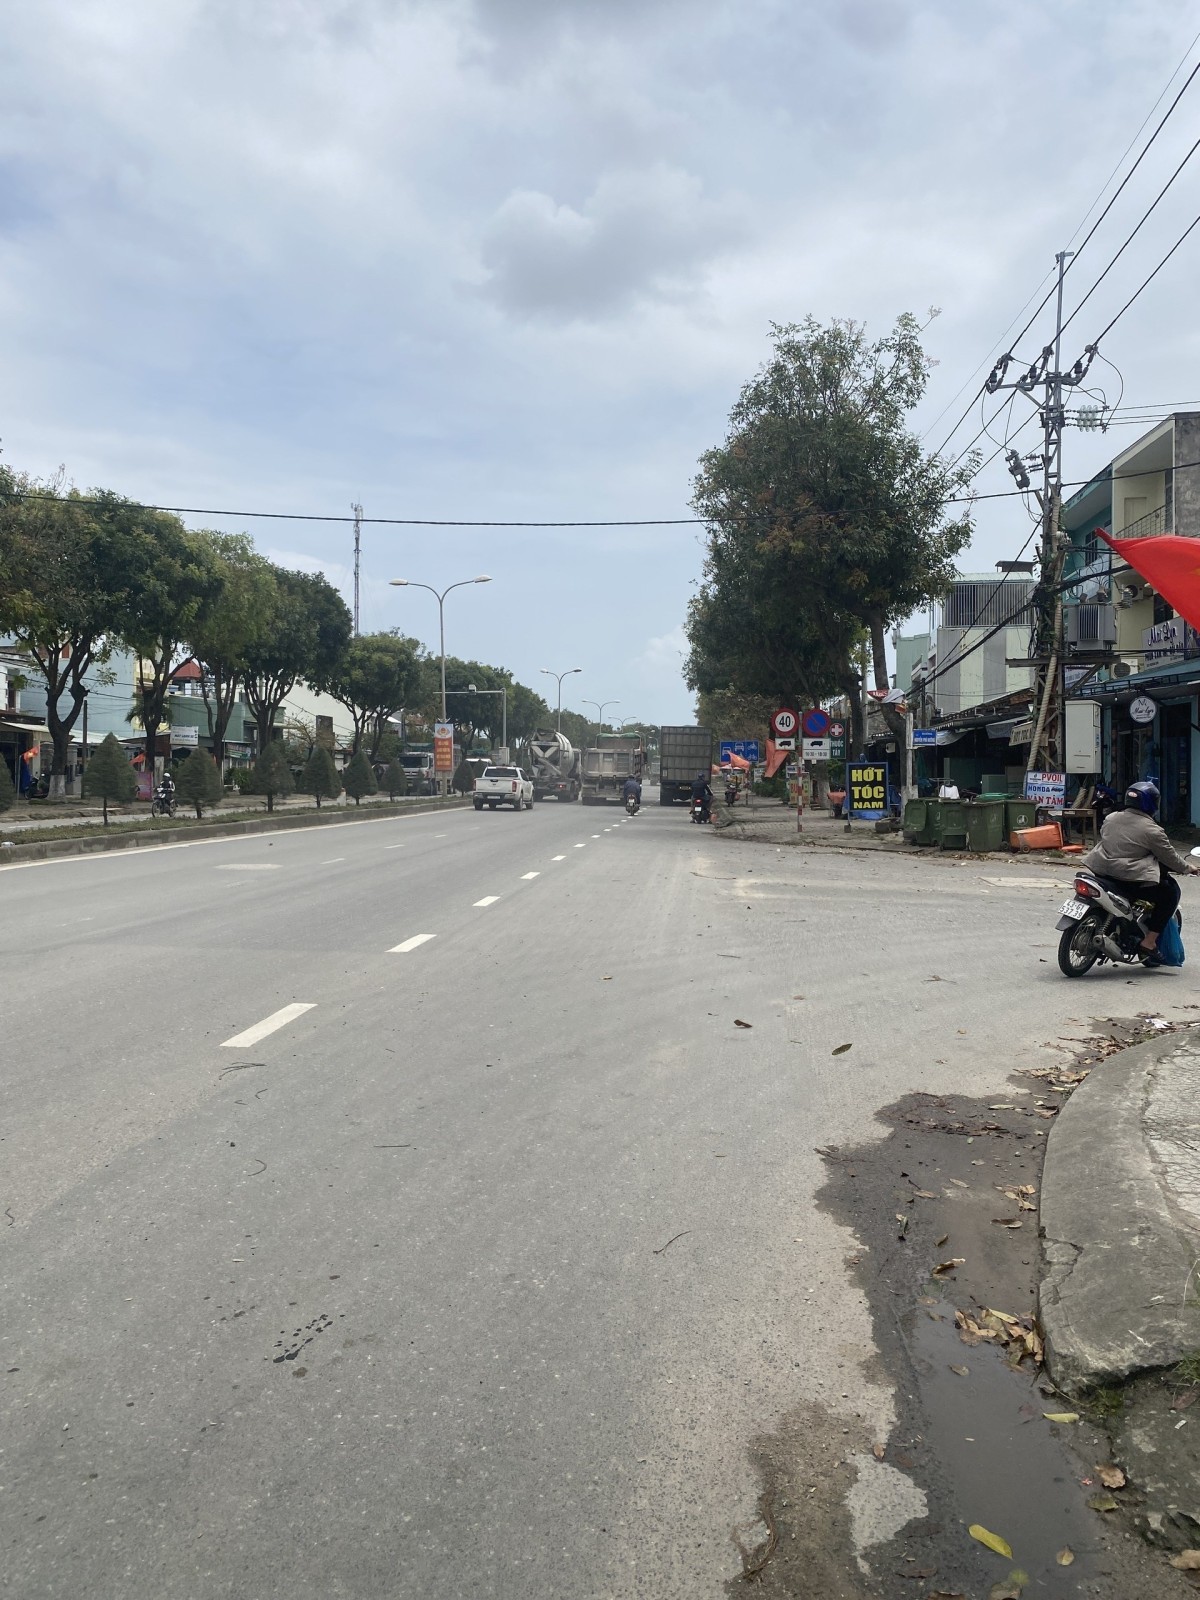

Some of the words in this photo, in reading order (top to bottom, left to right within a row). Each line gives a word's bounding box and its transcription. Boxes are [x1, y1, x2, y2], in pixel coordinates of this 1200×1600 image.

[779, 716, 790, 727] 40
[852, 767, 884, 781] HỚT
[1042, 774, 1062, 782] PVOIL
[852, 785, 884, 798] TÓC
